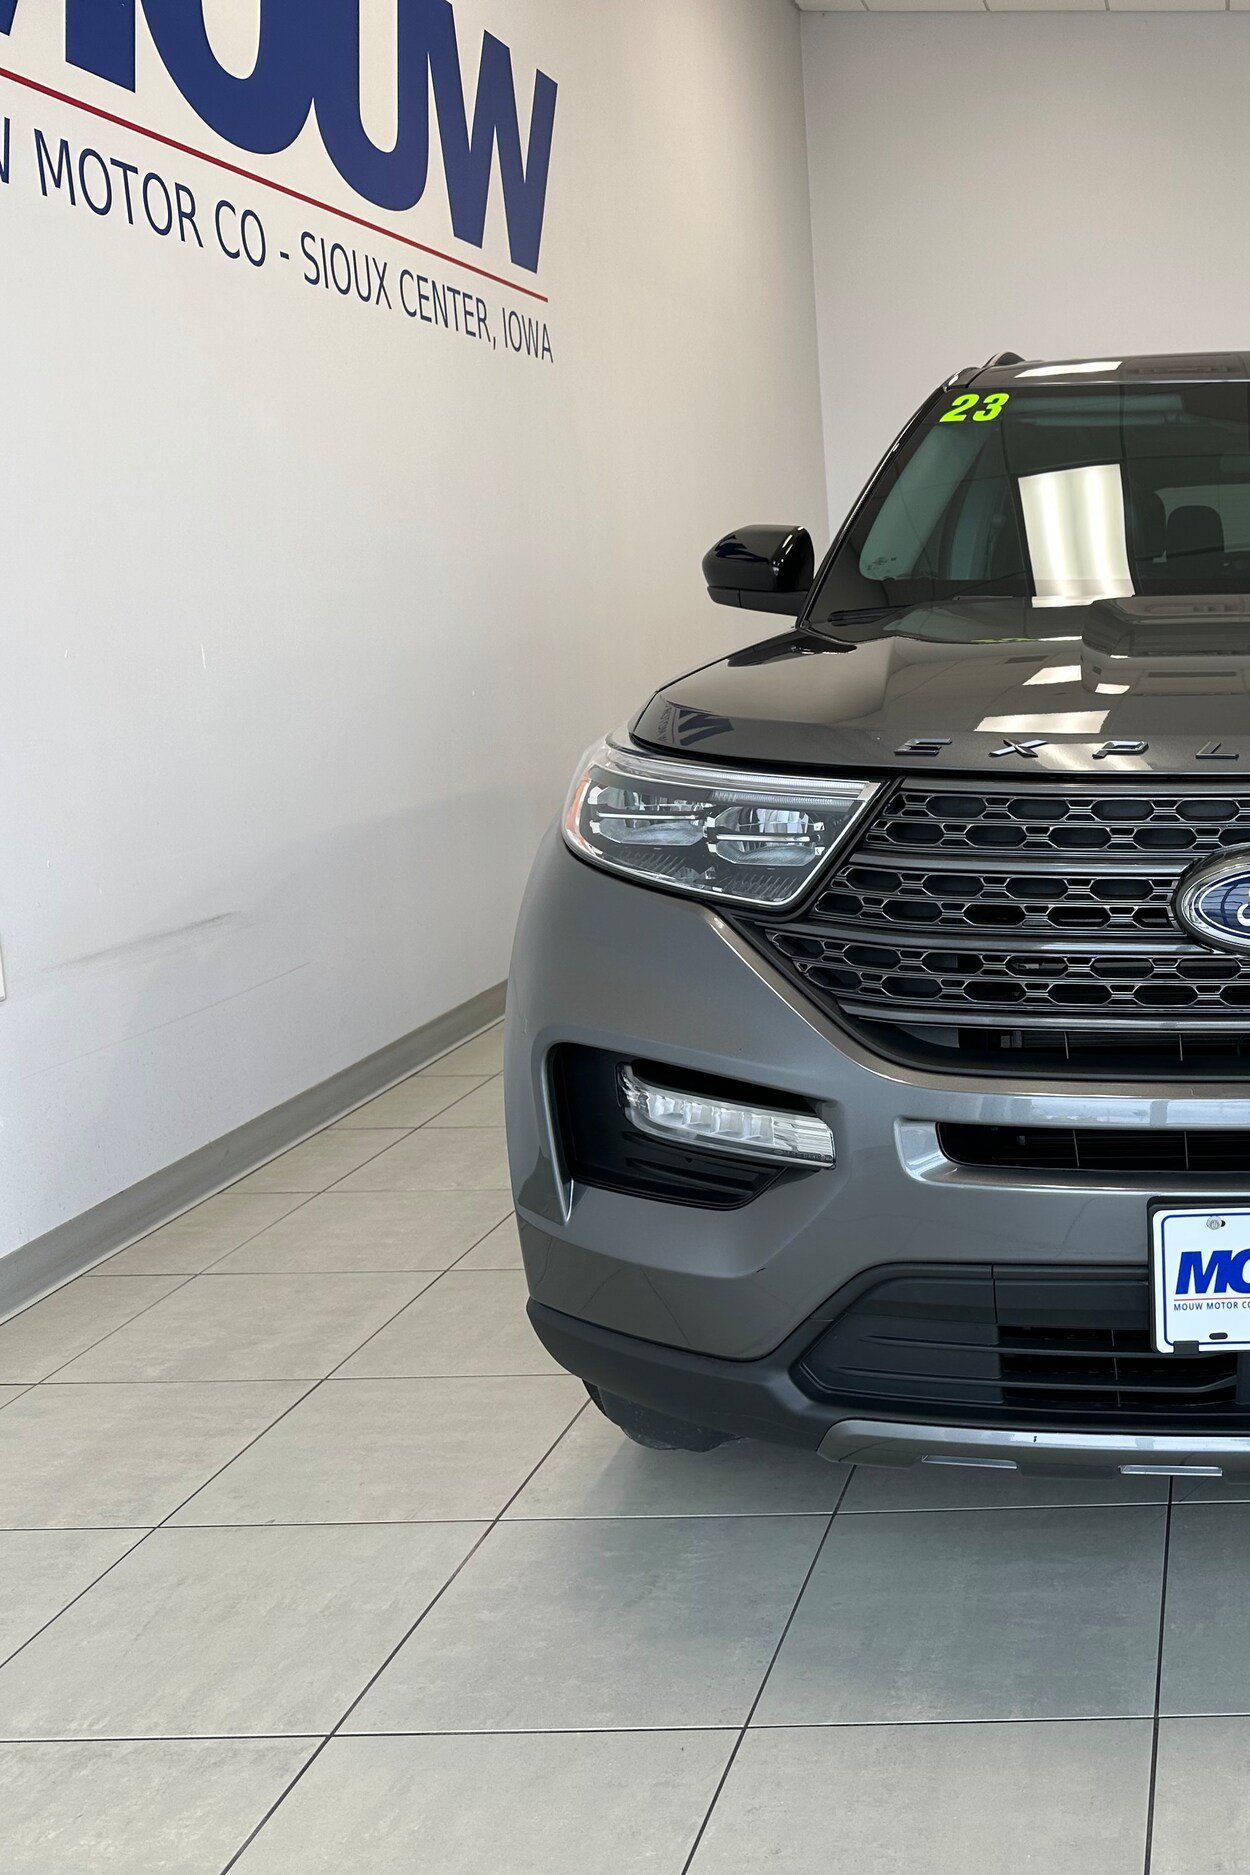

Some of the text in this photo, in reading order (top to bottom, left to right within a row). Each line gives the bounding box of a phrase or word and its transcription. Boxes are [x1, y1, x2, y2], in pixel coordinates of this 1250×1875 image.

[0, 0, 558, 273] OUW
[34, 128, 204, 248] MOTOR
[215, 199, 266, 267] CO
[300, 231, 392, 310] SIOUX
[399, 269, 497, 351] CENTER,
[502, 308, 554, 363] IOWA
[939, 392, 1010, 423] 23
[1173, 1302, 1203, 1312] MOUW
[1206, 1301, 1239, 1310] MOTOR
